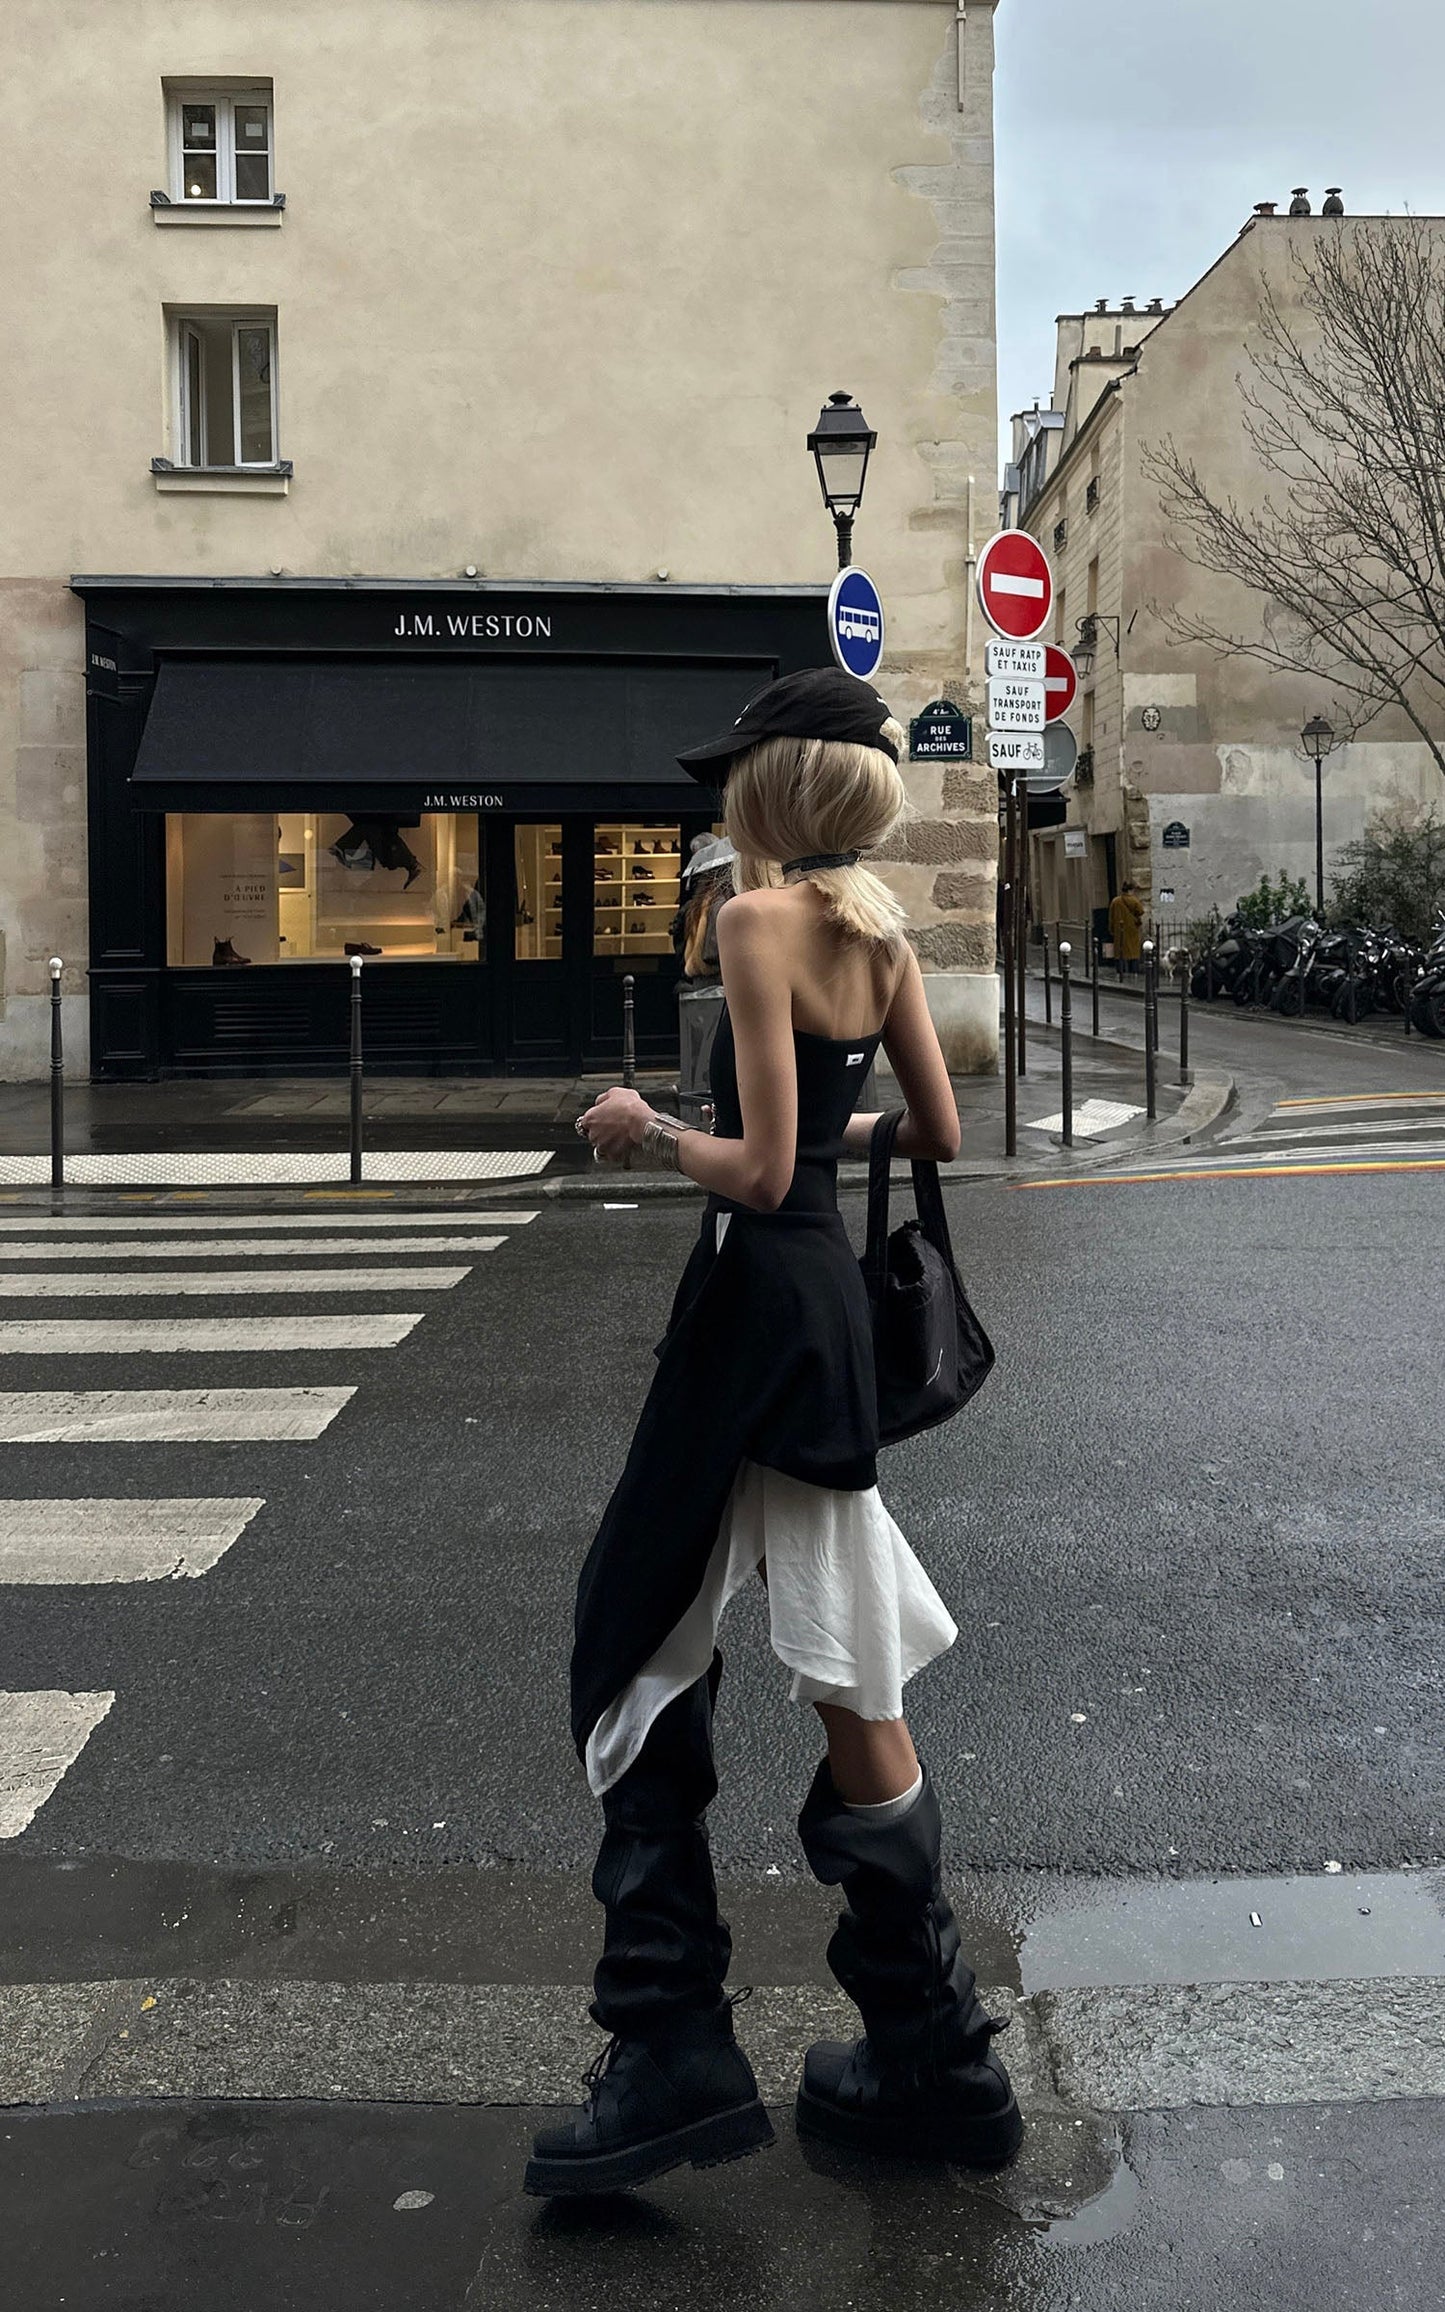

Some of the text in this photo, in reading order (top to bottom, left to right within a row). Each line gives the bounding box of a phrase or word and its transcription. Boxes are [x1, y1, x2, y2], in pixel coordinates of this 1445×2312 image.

[394, 615, 551, 637] J.M. WESTON
[993, 647, 1042, 660] SAUF RATP
[998, 660, 1037, 672] ET TAXIS
[1006, 686, 1029, 696] SAUF
[993, 698, 1042, 710] TRANSPORT
[994, 711, 1040, 723] DE FONDS
[930, 725, 952, 735] RUE
[916, 742, 966, 752] ARCHIVES
[992, 743, 1021, 758] SAUF
[423, 795, 503, 807] J.M. WESTON
